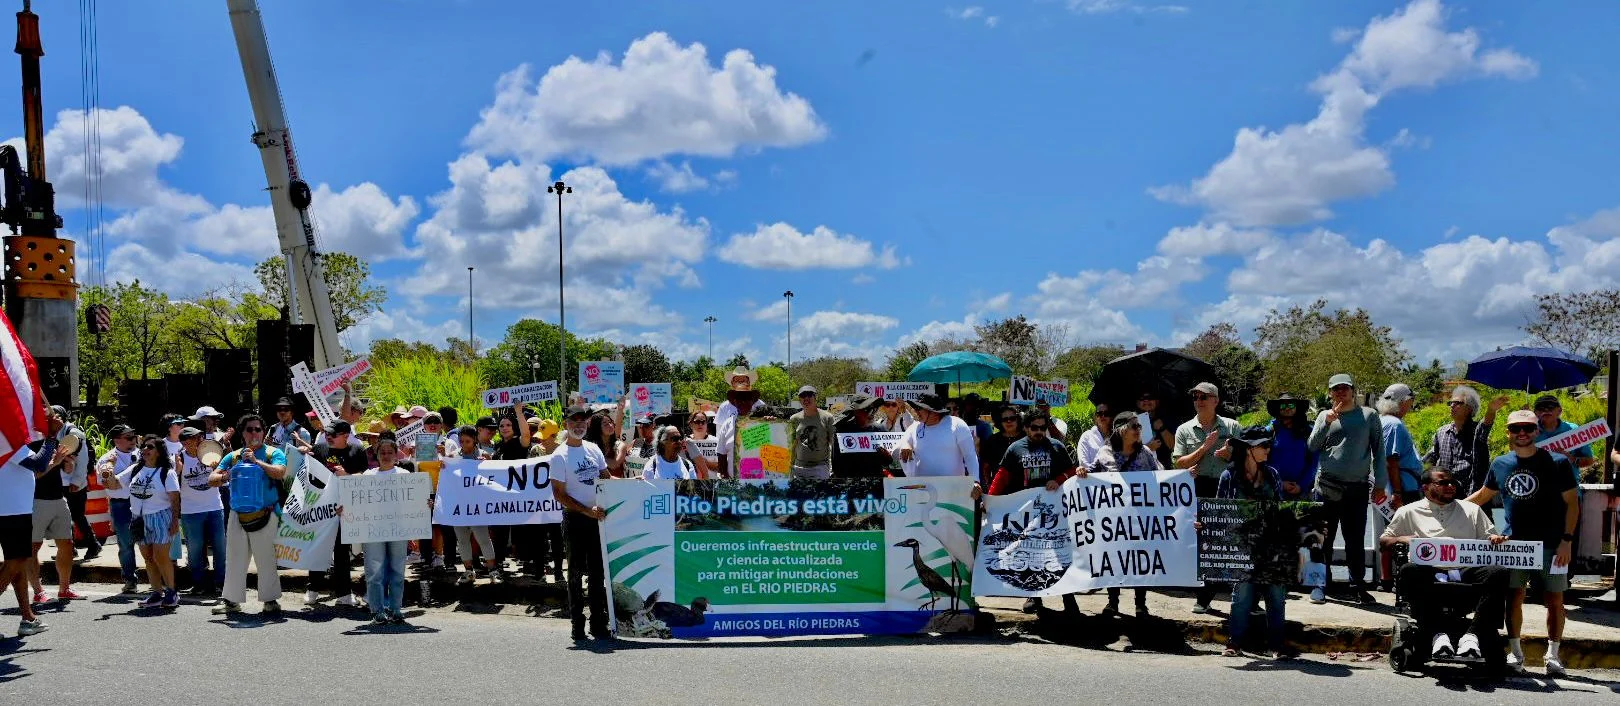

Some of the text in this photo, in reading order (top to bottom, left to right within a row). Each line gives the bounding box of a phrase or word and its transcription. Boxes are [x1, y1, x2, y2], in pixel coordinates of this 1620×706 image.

[586, 368, 599, 376] NO
[500, 391, 509, 404] NO
[637, 390, 648, 398] NO
[875, 386, 884, 398] NO
[858, 436, 870, 449] NO
[1023, 460, 1051, 468] CALLAR
[464, 476, 494, 488] DILE
[507, 462, 550, 491] NO
[352, 488, 414, 506] PRESENTE
[1062, 482, 1192, 518] SALVAR EL RIO
[453, 504, 460, 515] A
[467, 504, 480, 515] LA
[644, 493, 906, 520] ¡El Río Piedras está vivo!
[280, 525, 315, 541] CUENCA
[1074, 516, 1178, 547] ES SALVAR
[681, 540, 877, 552] Queremos infraestructura verde
[1440, 544, 1457, 561] NO
[1478, 543, 1535, 553] CANALIZACIÓN
[716, 554, 842, 568] y ciencia actualizada
[1089, 550, 1166, 578] LA VIDA
[1476, 553, 1492, 565] RÍO
[1495, 556, 1535, 566] PIEDRAS
[698, 568, 858, 582] para mitigar inundaciones
[723, 585, 738, 594] en
[742, 583, 756, 593] EL
[784, 582, 837, 593] PIEDRAS
[713, 618, 859, 630] AMIGOS DEL RÍO PIEDRAS
